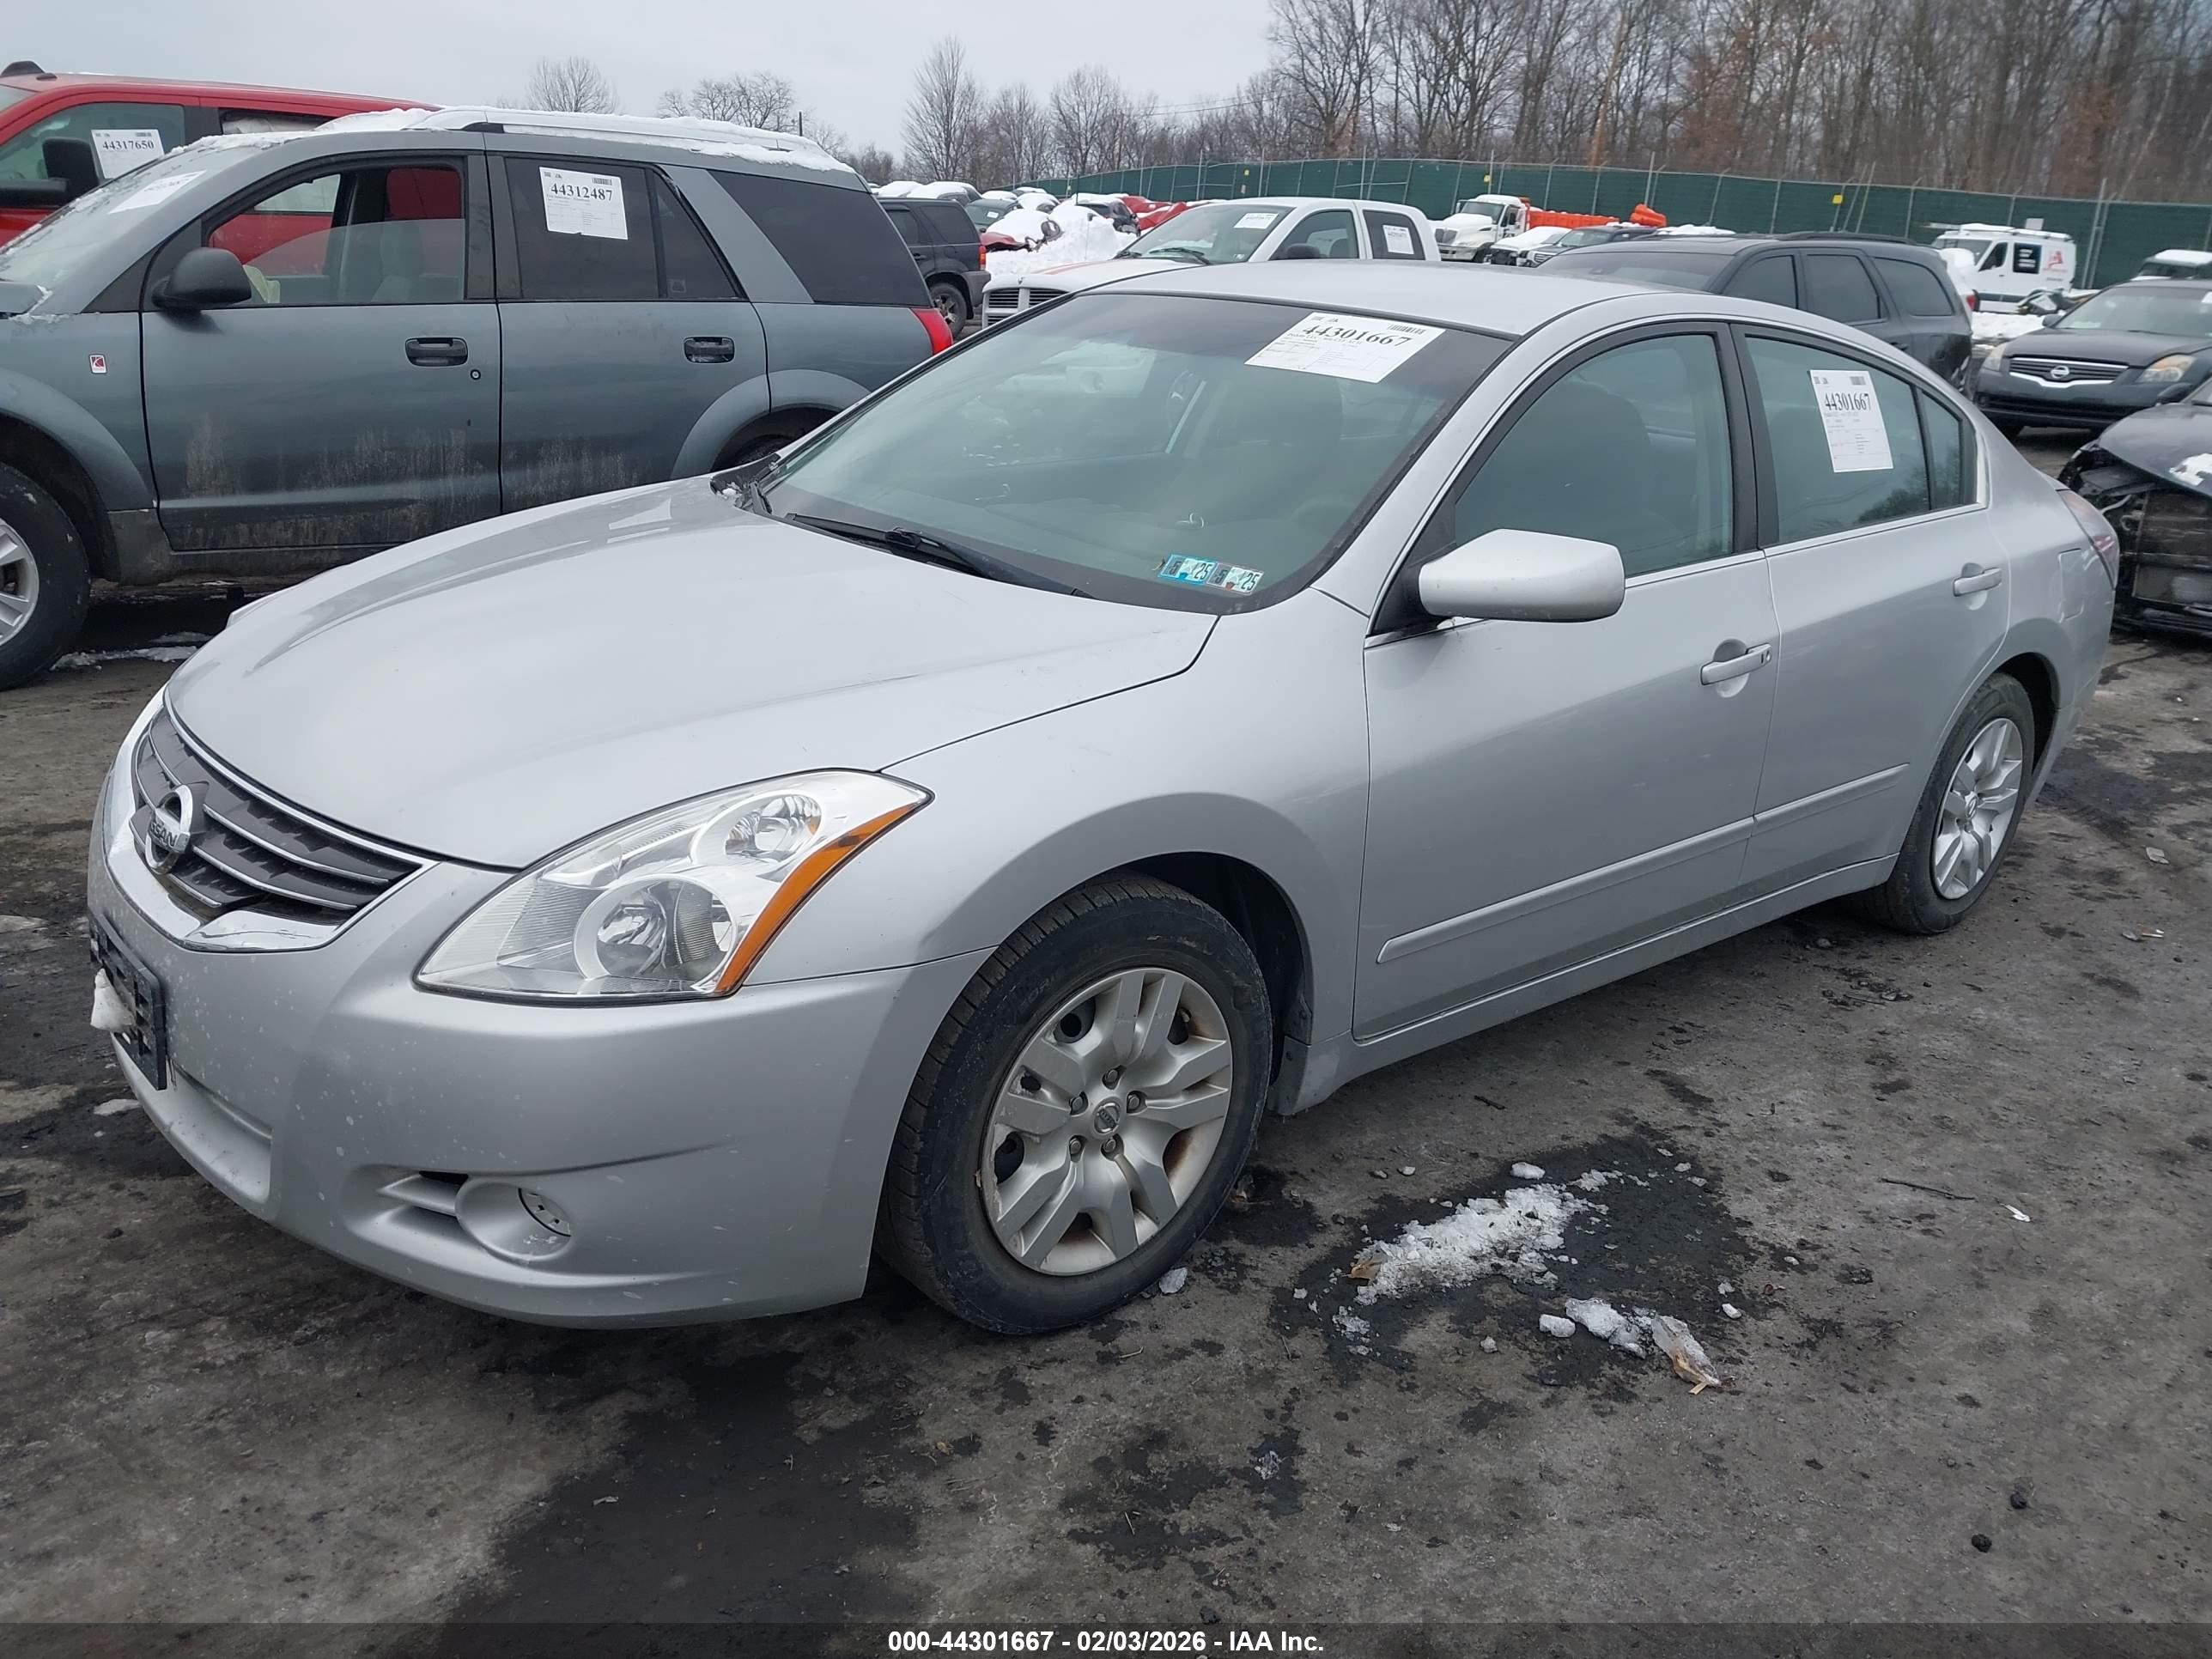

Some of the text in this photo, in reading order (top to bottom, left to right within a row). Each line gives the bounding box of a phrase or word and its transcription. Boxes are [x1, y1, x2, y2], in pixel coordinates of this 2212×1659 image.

[102, 140, 155, 150] 44317650
[550, 183, 613, 202] 44312487
[1302, 324, 1413, 347] 44301667
[1825, 392, 1871, 411] 44301667
[1194, 562, 1212, 580] 25
[1240, 573, 1261, 591] 25
